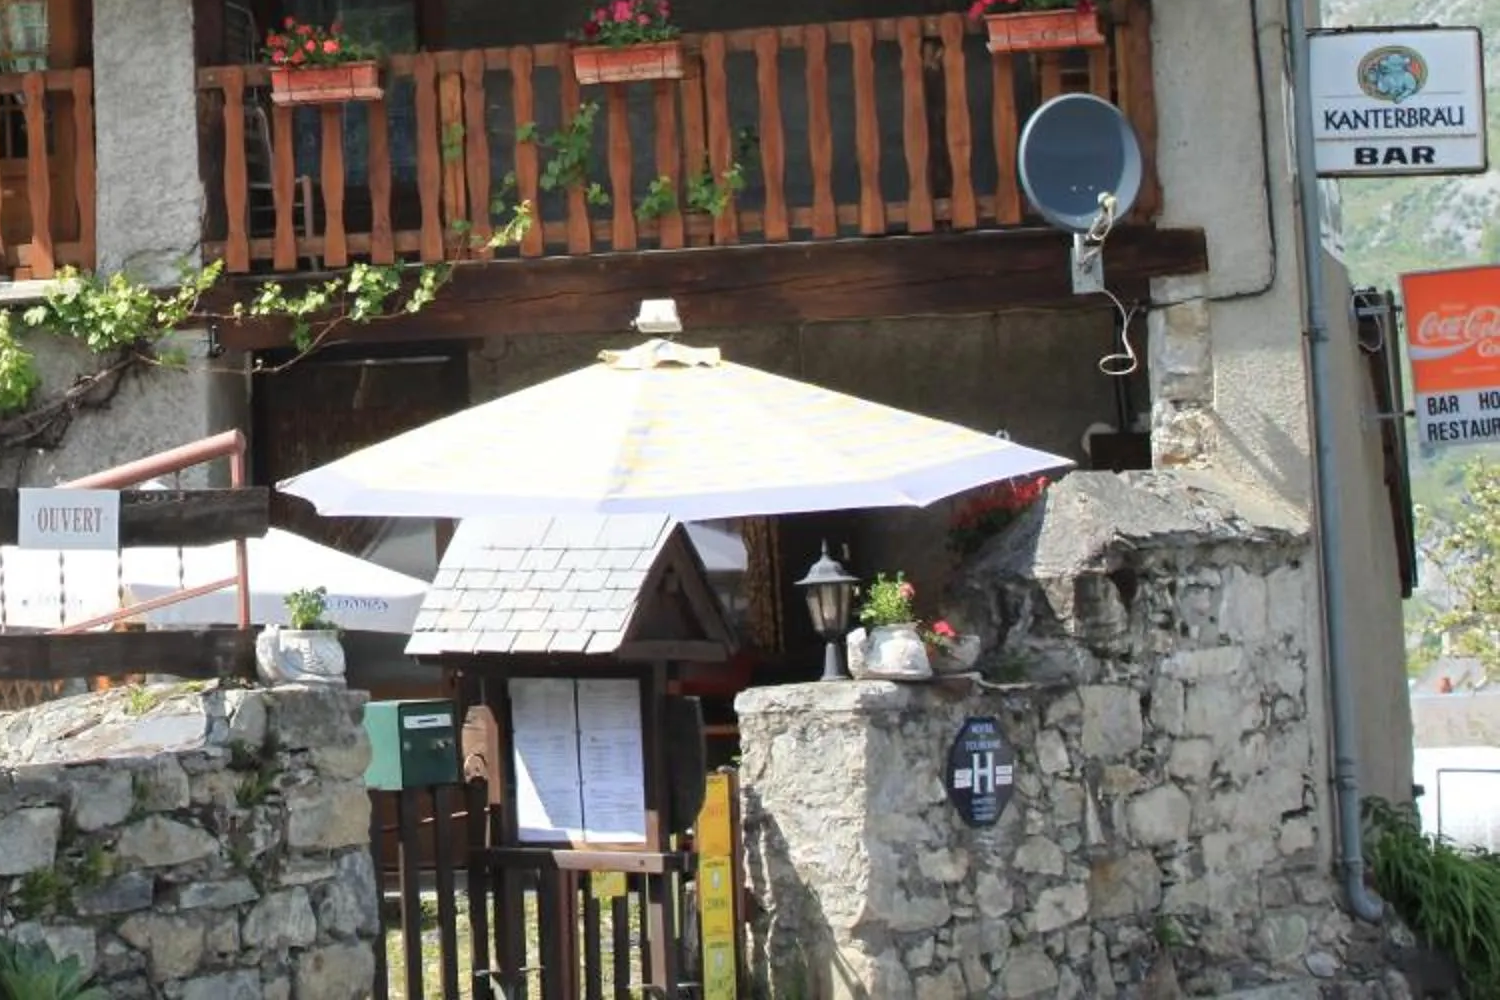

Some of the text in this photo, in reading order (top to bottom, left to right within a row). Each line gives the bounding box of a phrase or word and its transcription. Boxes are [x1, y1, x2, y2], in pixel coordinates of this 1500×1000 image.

[1353, 145, 1437, 166] BAR
[1427, 395, 1459, 416] BAR
[37, 507, 102, 533] OUVERT
[972, 751, 995, 794] H
